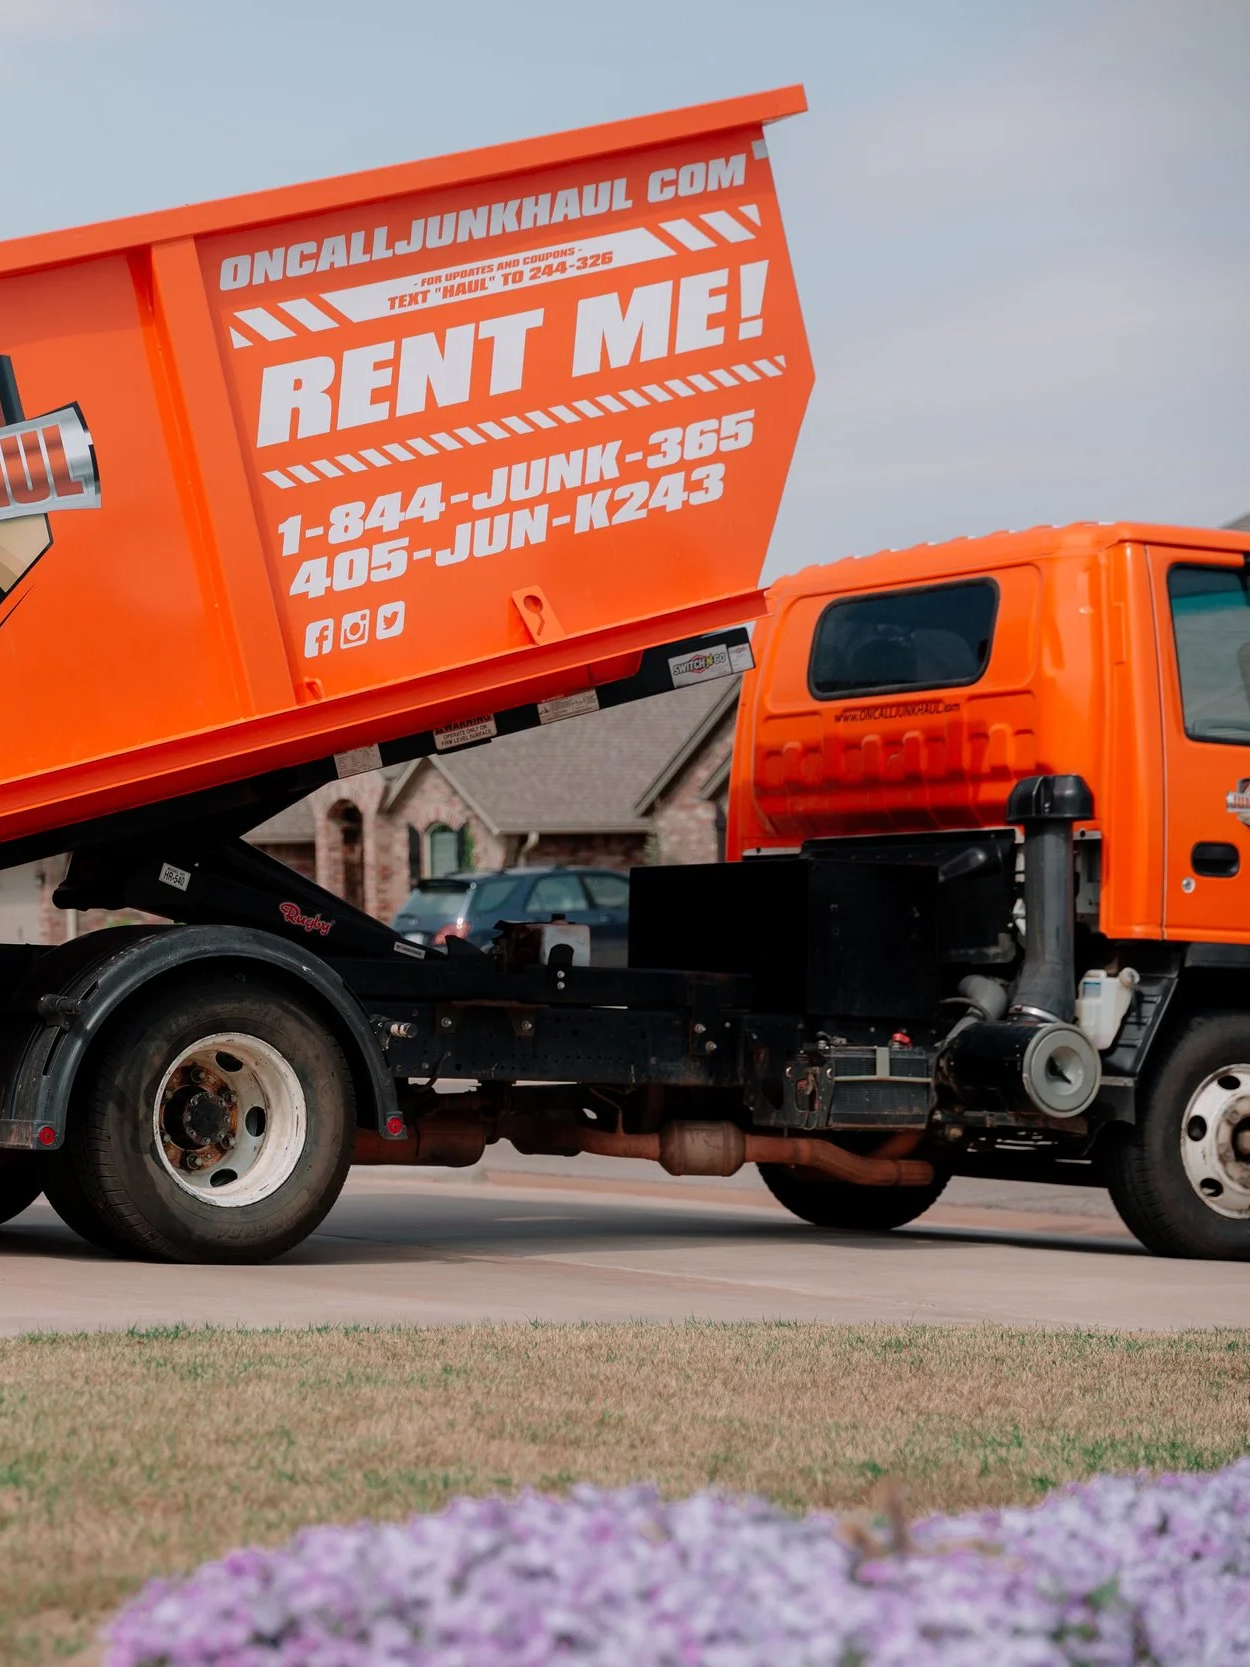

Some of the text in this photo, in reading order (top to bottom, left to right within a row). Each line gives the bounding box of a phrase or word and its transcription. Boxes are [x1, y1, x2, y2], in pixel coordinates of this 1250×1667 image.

[219, 153, 747, 291] ONCALLJUNKHAUL COM
[387, 251, 614, 311] TEXT "HAUL" TO 244-326
[420, 247, 576, 287] FOR UPDATES AND COUPONS
[257, 260, 769, 447] RENT ME!
[277, 409, 755, 557] 1-844-JUNK-365
[289, 463, 726, 599] 405-JUN-K243
[442, 729, 466, 740] OPERATE
[453, 735, 470, 744] LEVEL
[279, 902, 331, 936] Rugby
